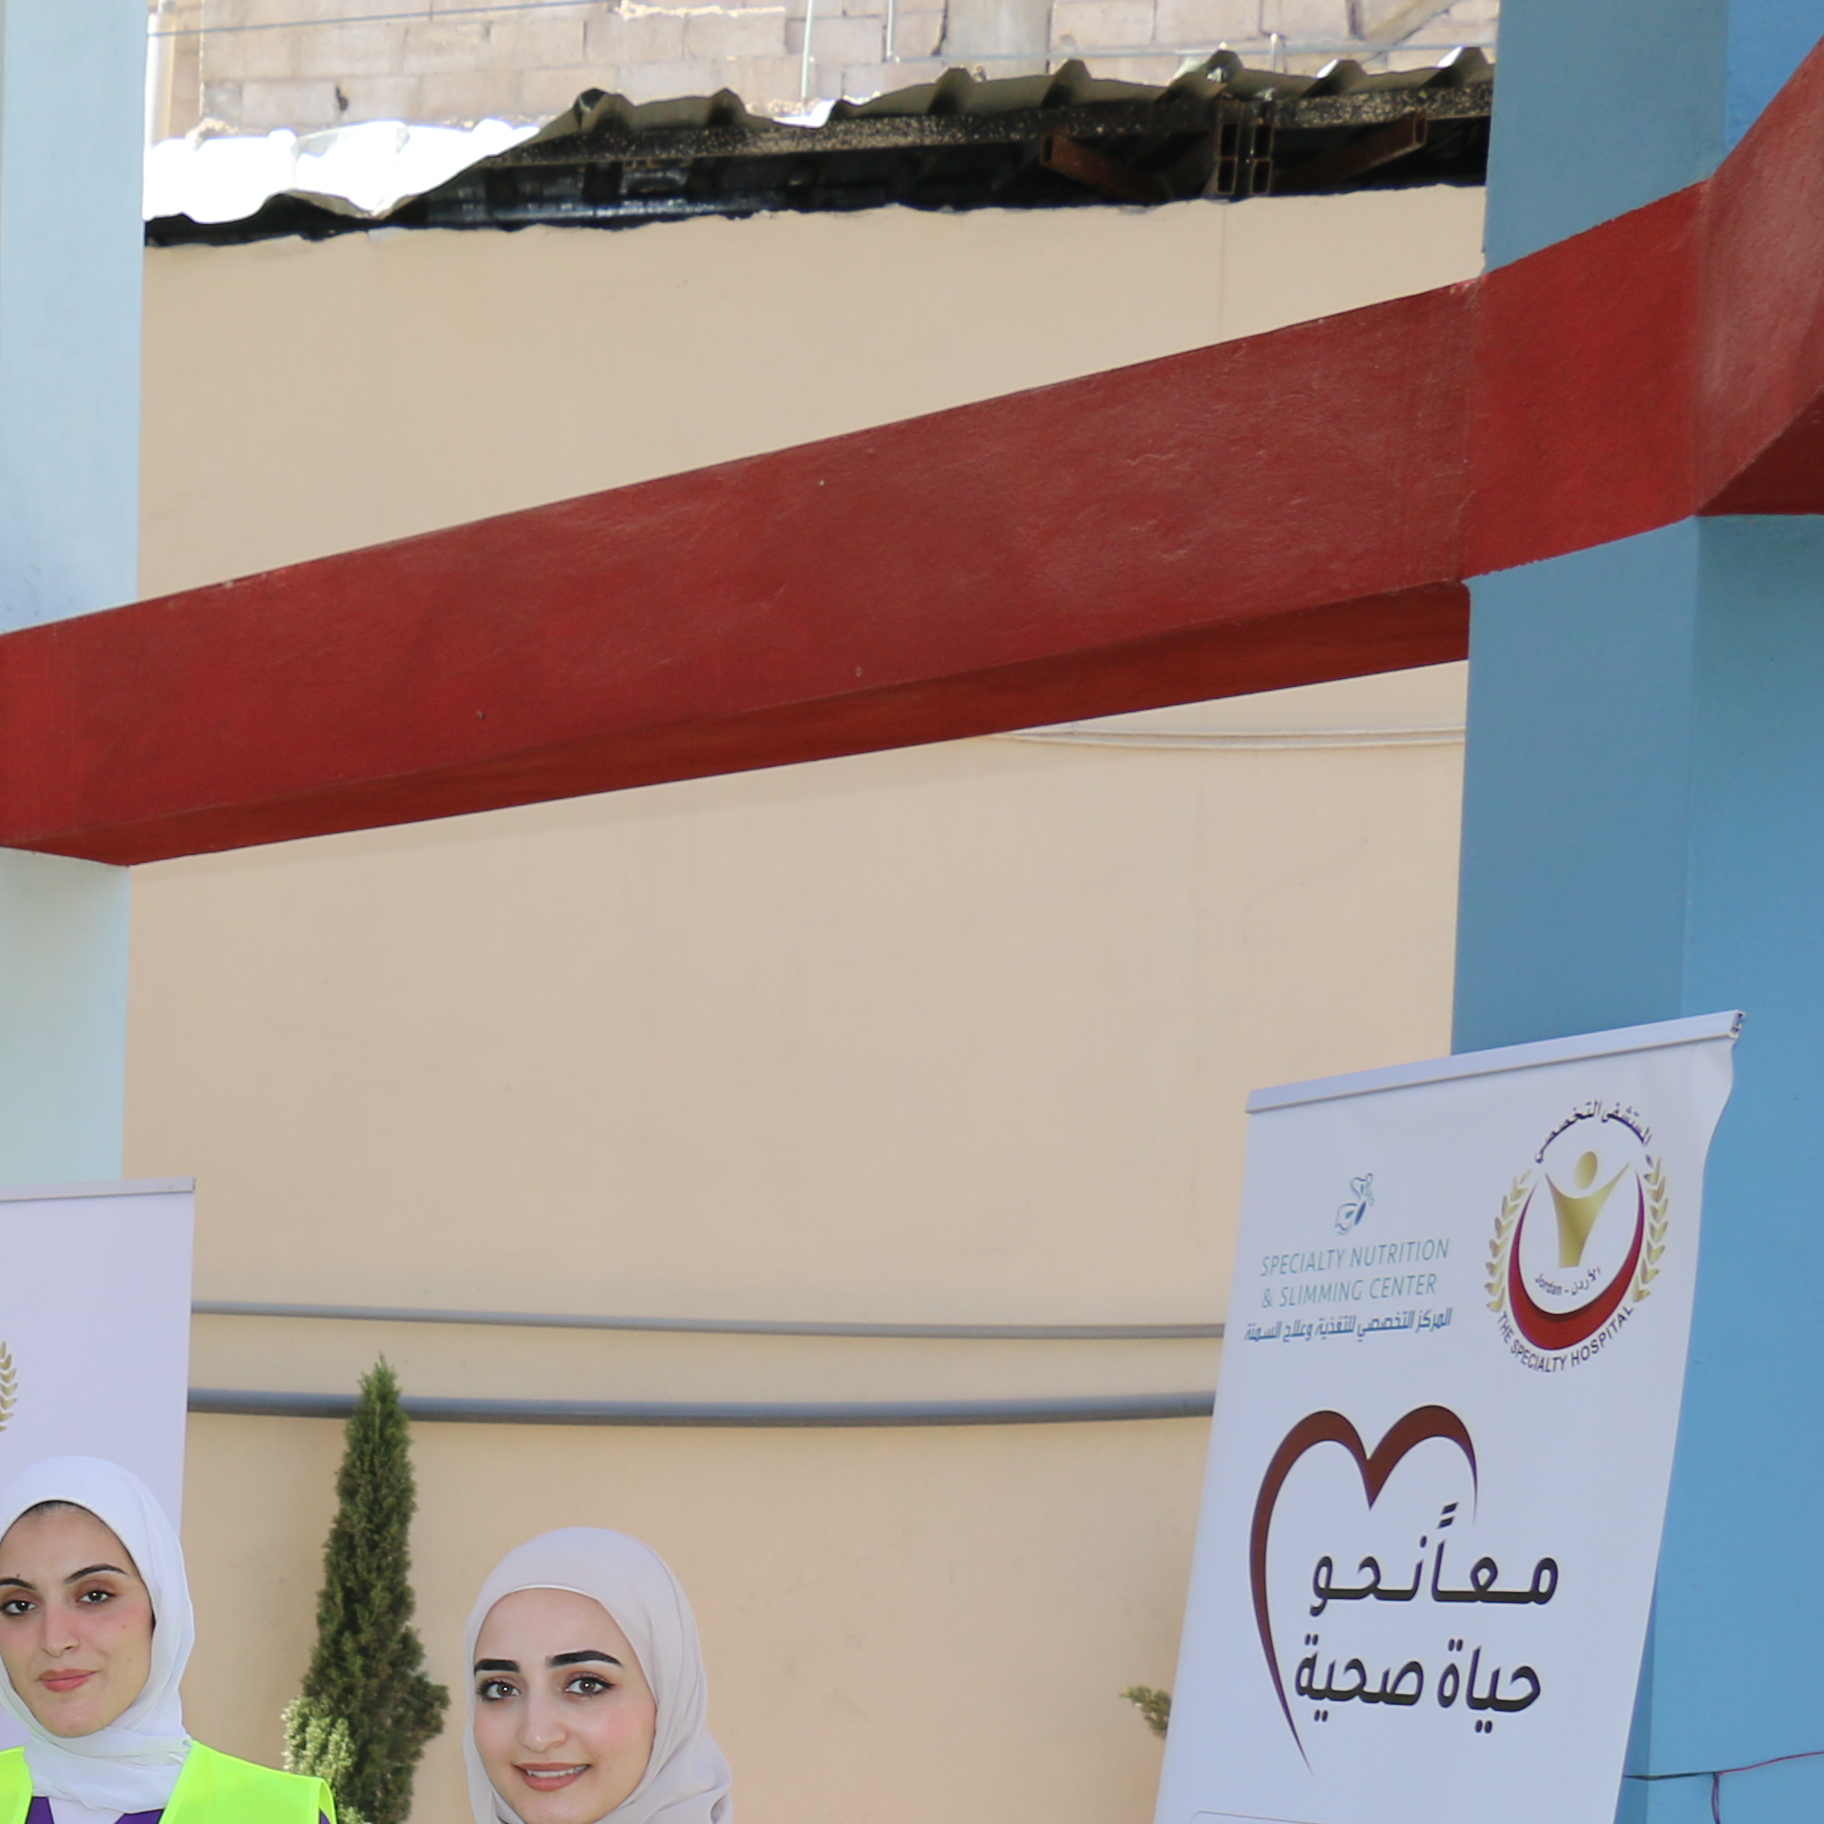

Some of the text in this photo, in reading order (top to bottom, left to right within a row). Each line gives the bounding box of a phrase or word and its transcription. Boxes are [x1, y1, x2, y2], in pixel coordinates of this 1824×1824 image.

[1260, 1237, 1450, 1277] SPECIALTY NUTRITION
[1261, 1272, 1438, 1309] & SLIMMING CENTER
[1534, 1273, 1562, 1296] Jordan
[1415, 1306, 1453, 1334] المركز
[1497, 1305, 1634, 1374] THE SPECIALTY HOSPITAL
[1309, 1535, 1428, 1617] نحو
[1294, 1633, 1542, 1734] حياة صحية
